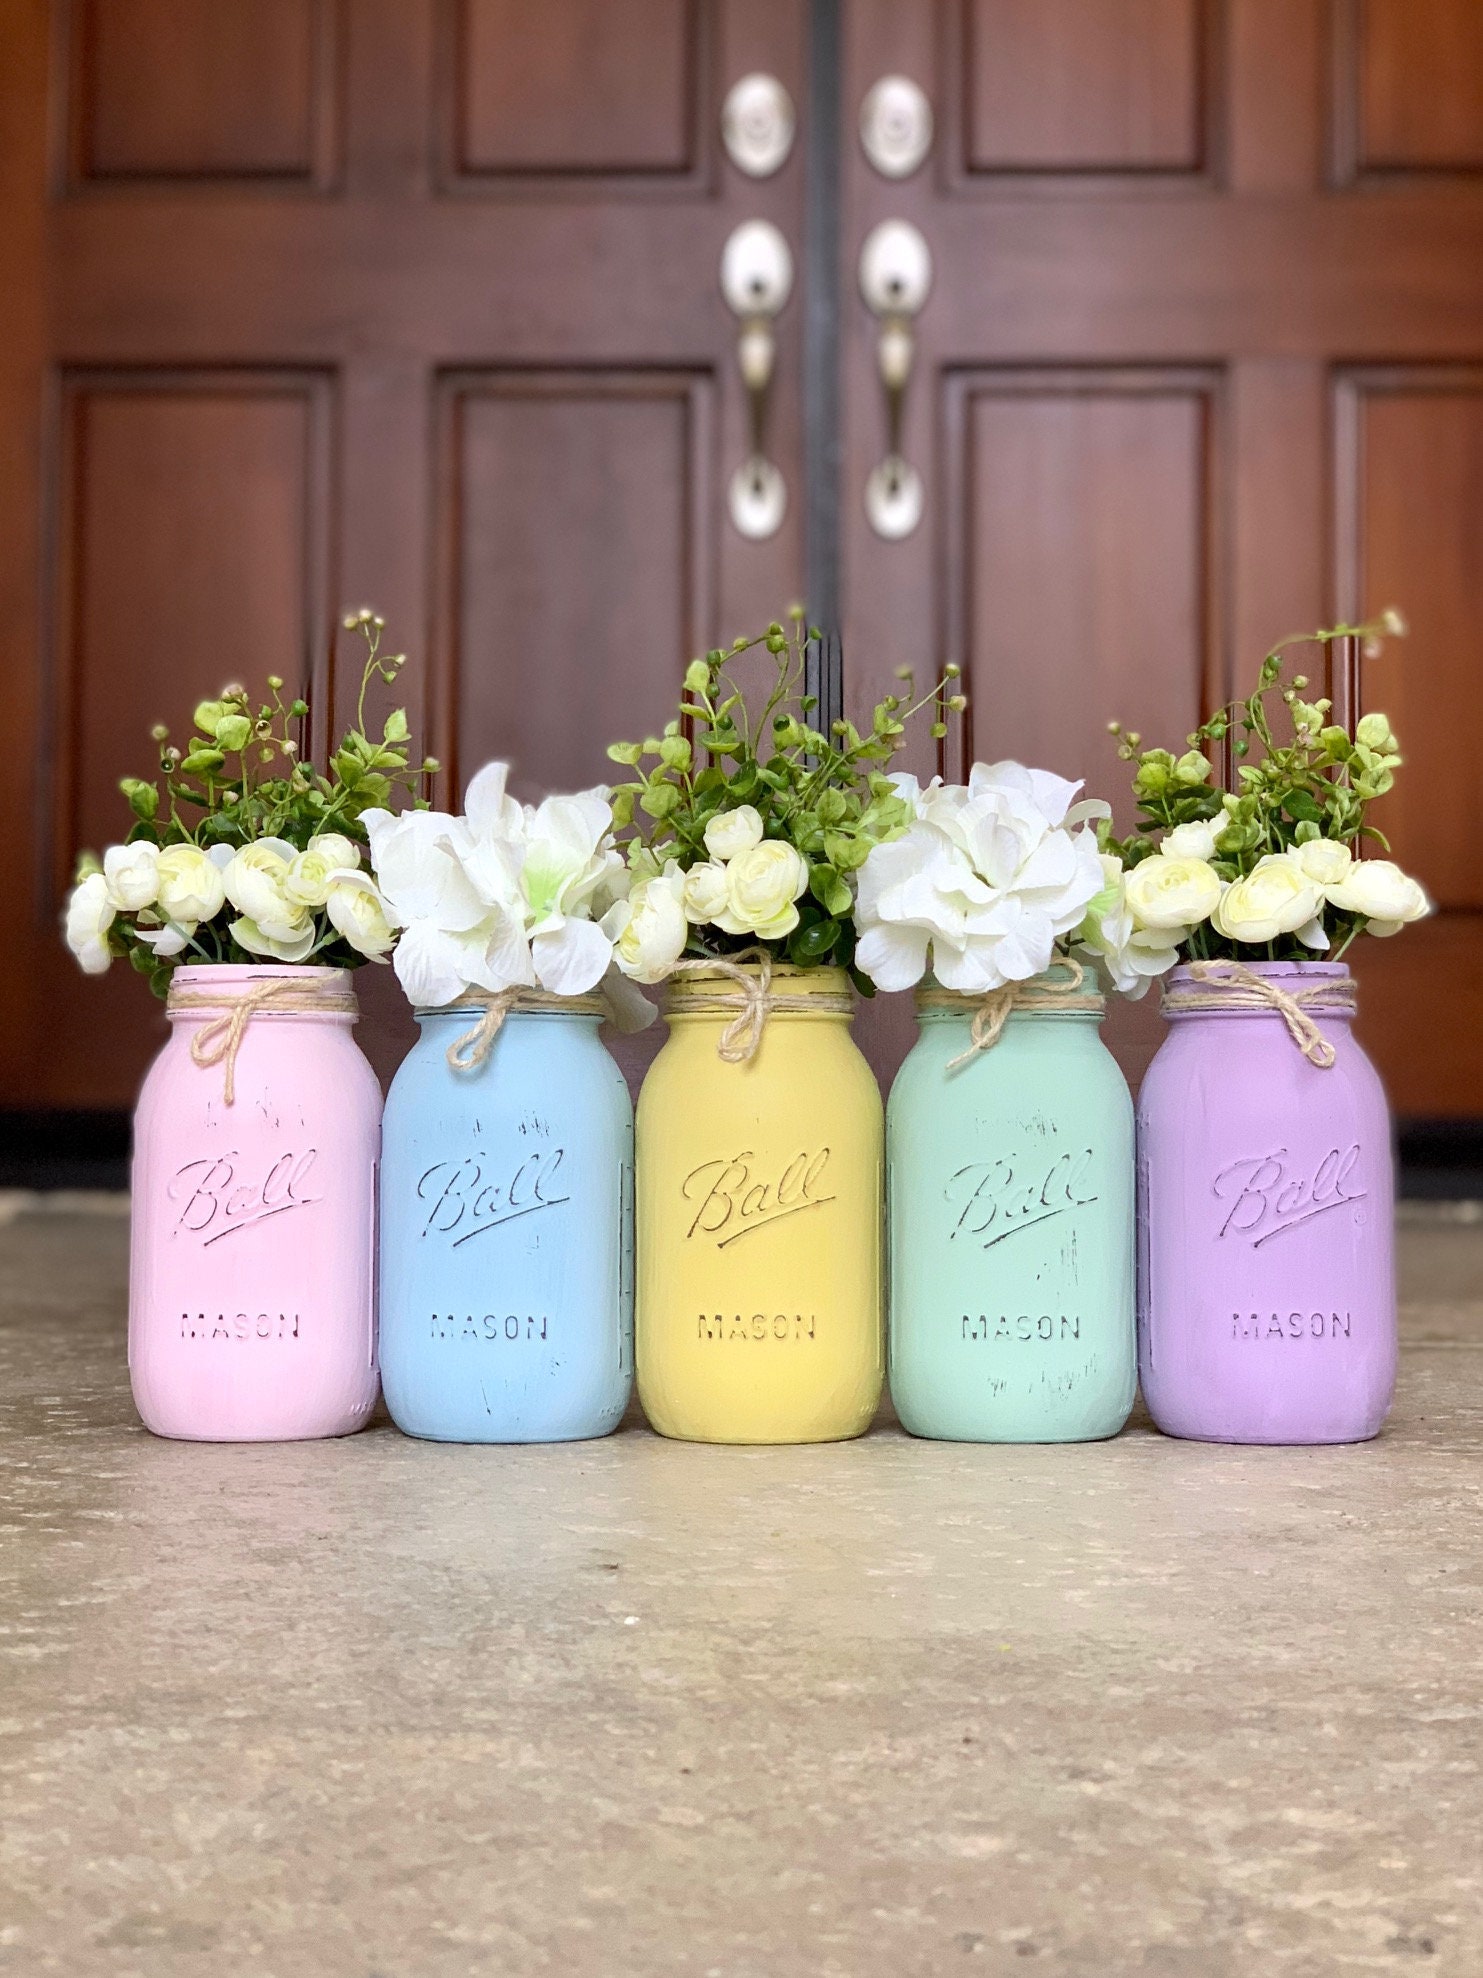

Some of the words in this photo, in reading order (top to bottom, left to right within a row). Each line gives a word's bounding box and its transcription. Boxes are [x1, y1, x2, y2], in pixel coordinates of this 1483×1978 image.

[166, 1147, 319, 1247] Ball
[416, 1147, 571, 1247] Ball
[682, 1146, 837, 1248] Ball
[944, 1148, 1099, 1249] Ball
[1212, 1144, 1368, 1248] Ball
[180, 1312, 300, 1339] MASON
[430, 1312, 549, 1340] MASON
[697, 1313, 817, 1340] MASON
[961, 1314, 1081, 1340] MASON
[1231, 1312, 1352, 1338] MASON
